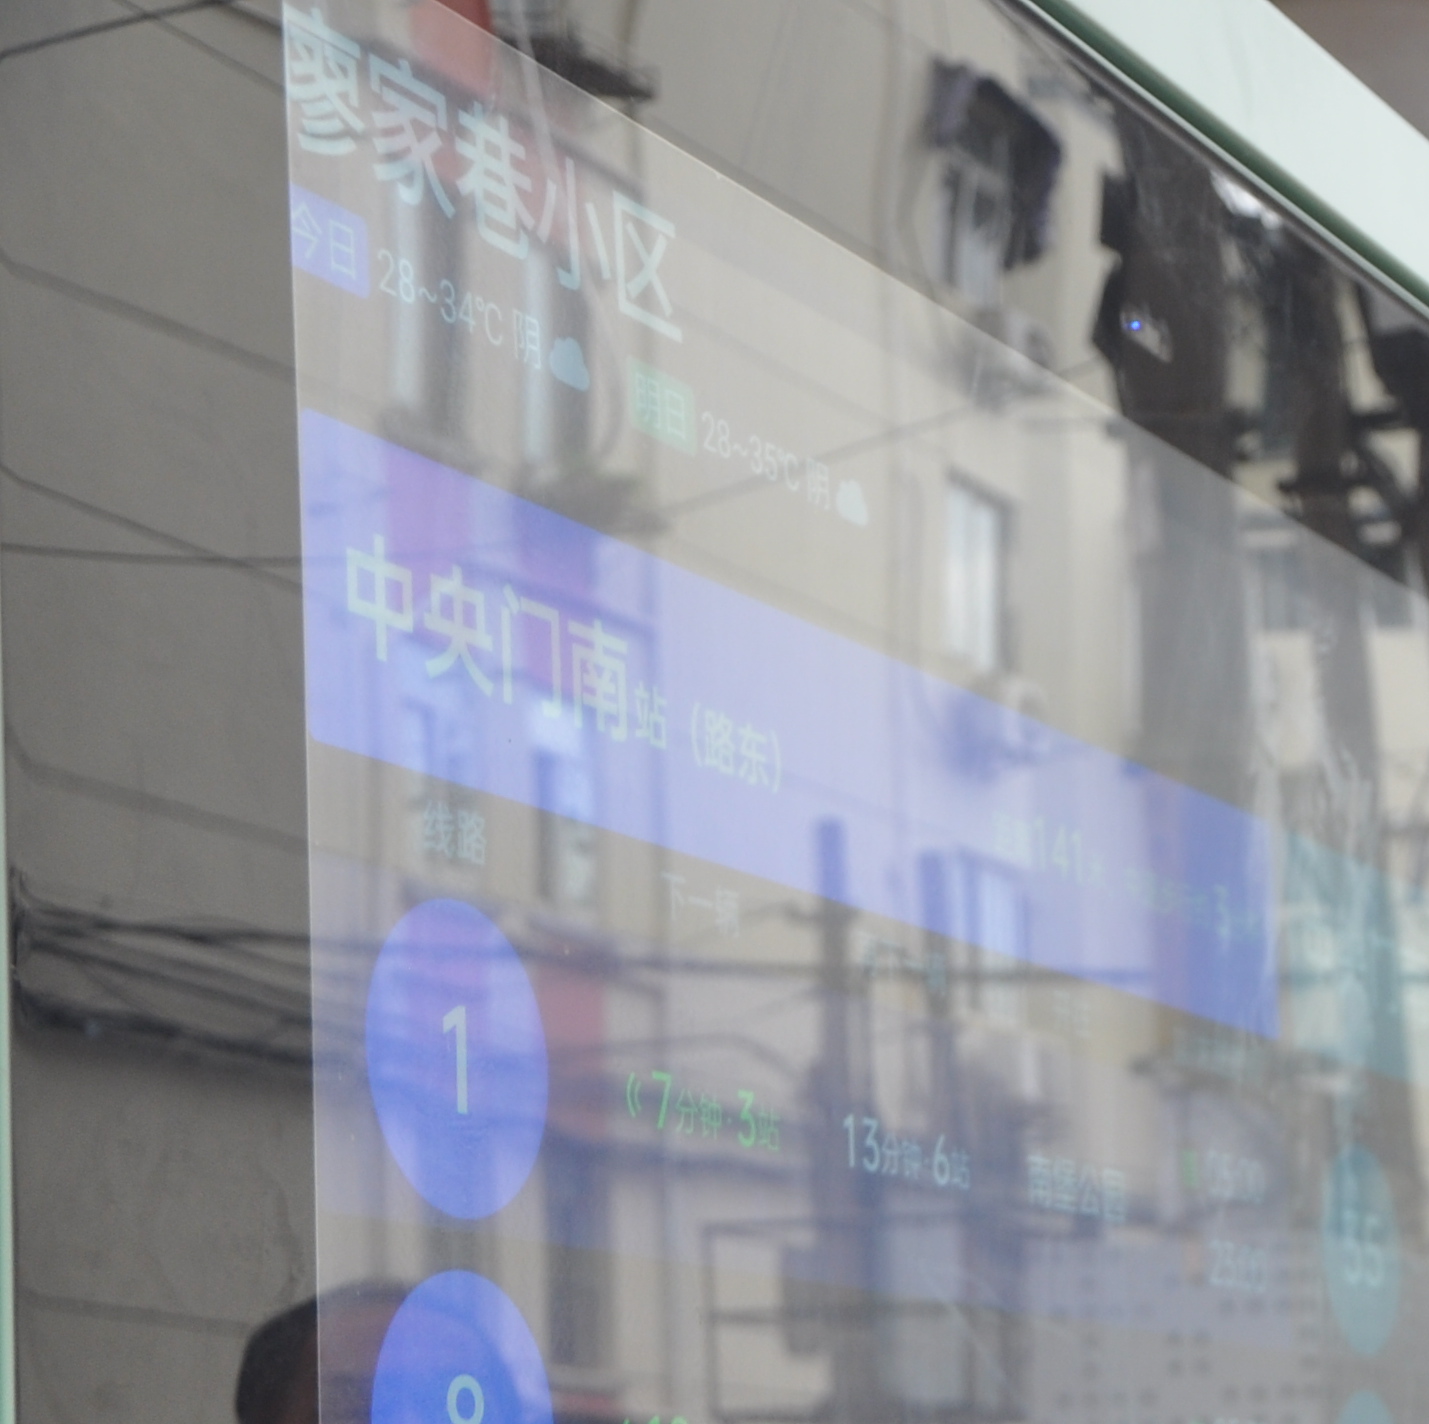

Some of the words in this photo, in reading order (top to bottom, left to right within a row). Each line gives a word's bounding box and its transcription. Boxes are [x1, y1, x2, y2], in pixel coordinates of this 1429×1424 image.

[291, 200, 357, 281] 今日
[512, 307, 542, 371] 阴
[635, 372, 687, 441] 明日
[422, 803, 486, 866] 线路
[441, 1004, 468, 1115] 1
